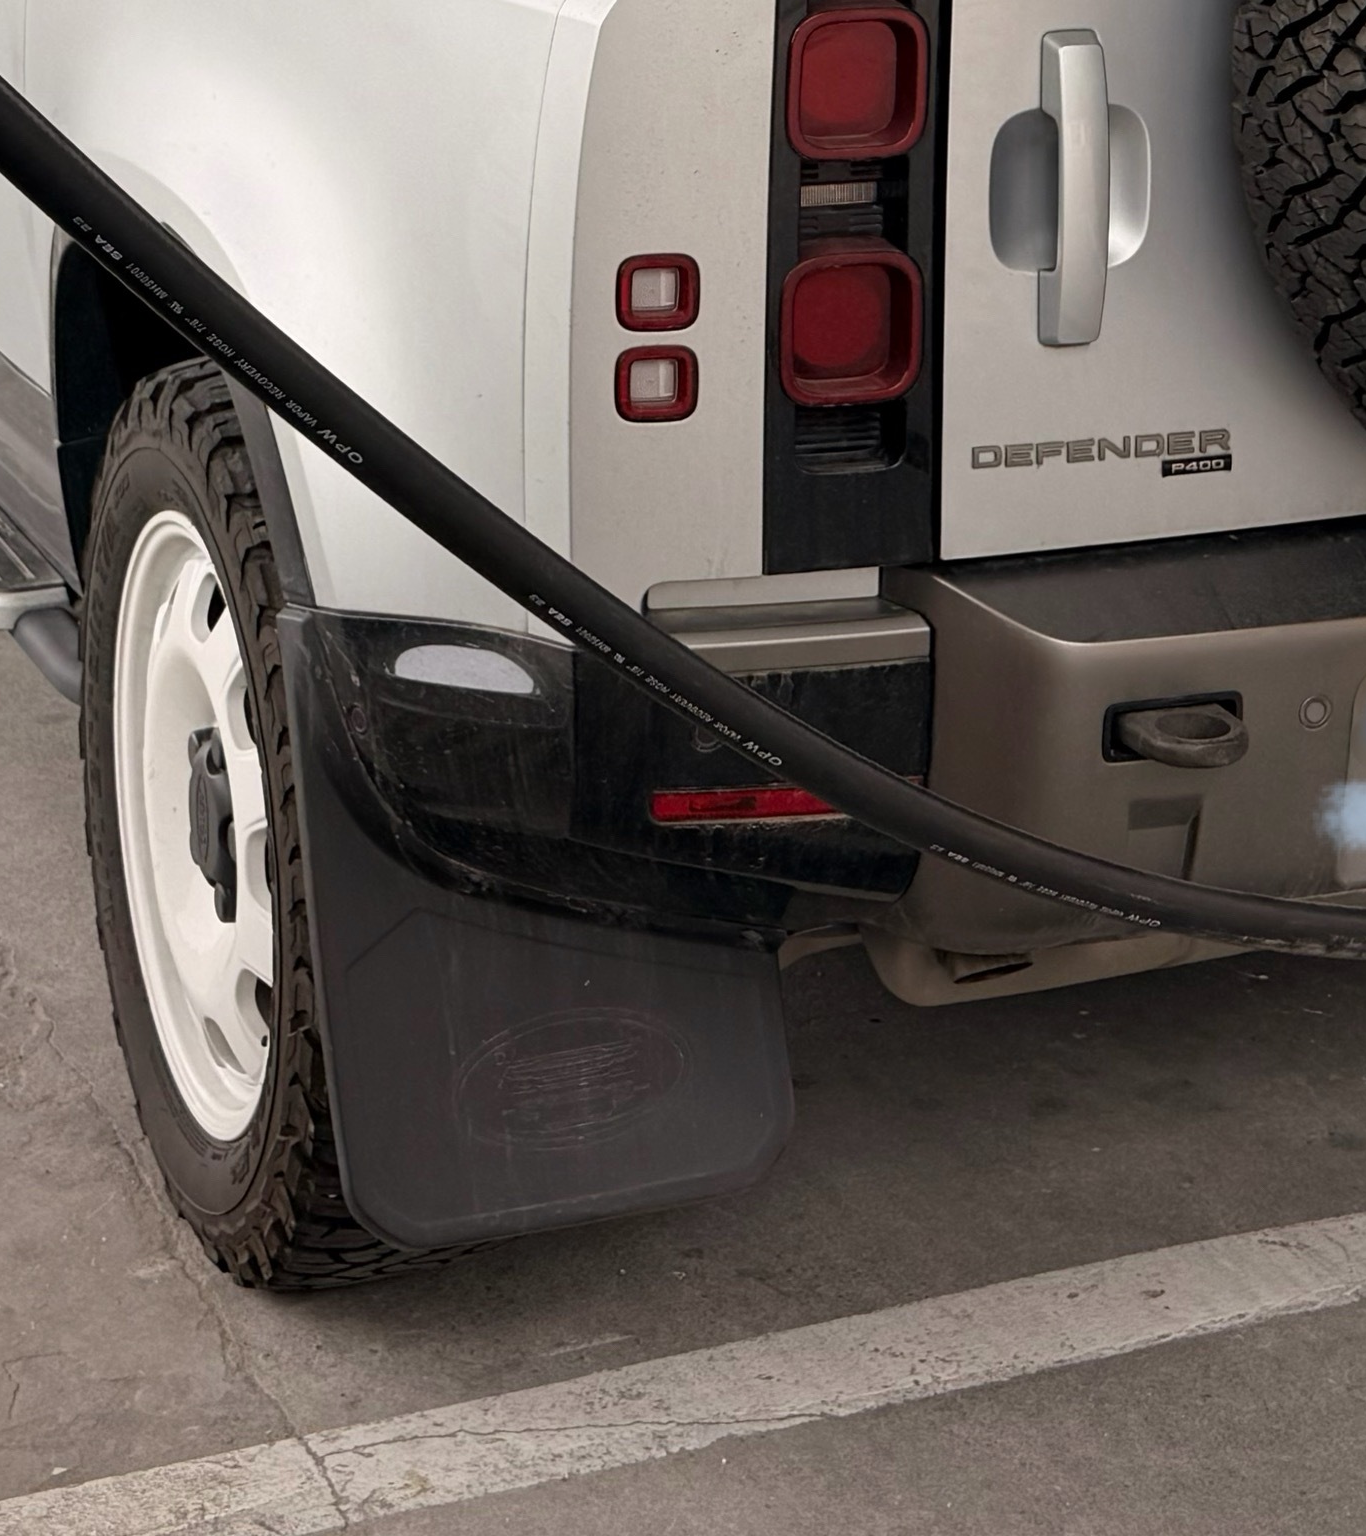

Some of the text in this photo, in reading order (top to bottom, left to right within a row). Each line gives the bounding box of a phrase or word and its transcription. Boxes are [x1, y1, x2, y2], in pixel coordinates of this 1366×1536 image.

[94, 234, 123, 261] SEA
[233, 358, 287, 400] RECOVERY
[316, 429, 364, 464] OPW
[971, 427, 1232, 470] DEFENDER
[1170, 458, 1226, 475] P400
[742, 741, 783, 766] OPW
